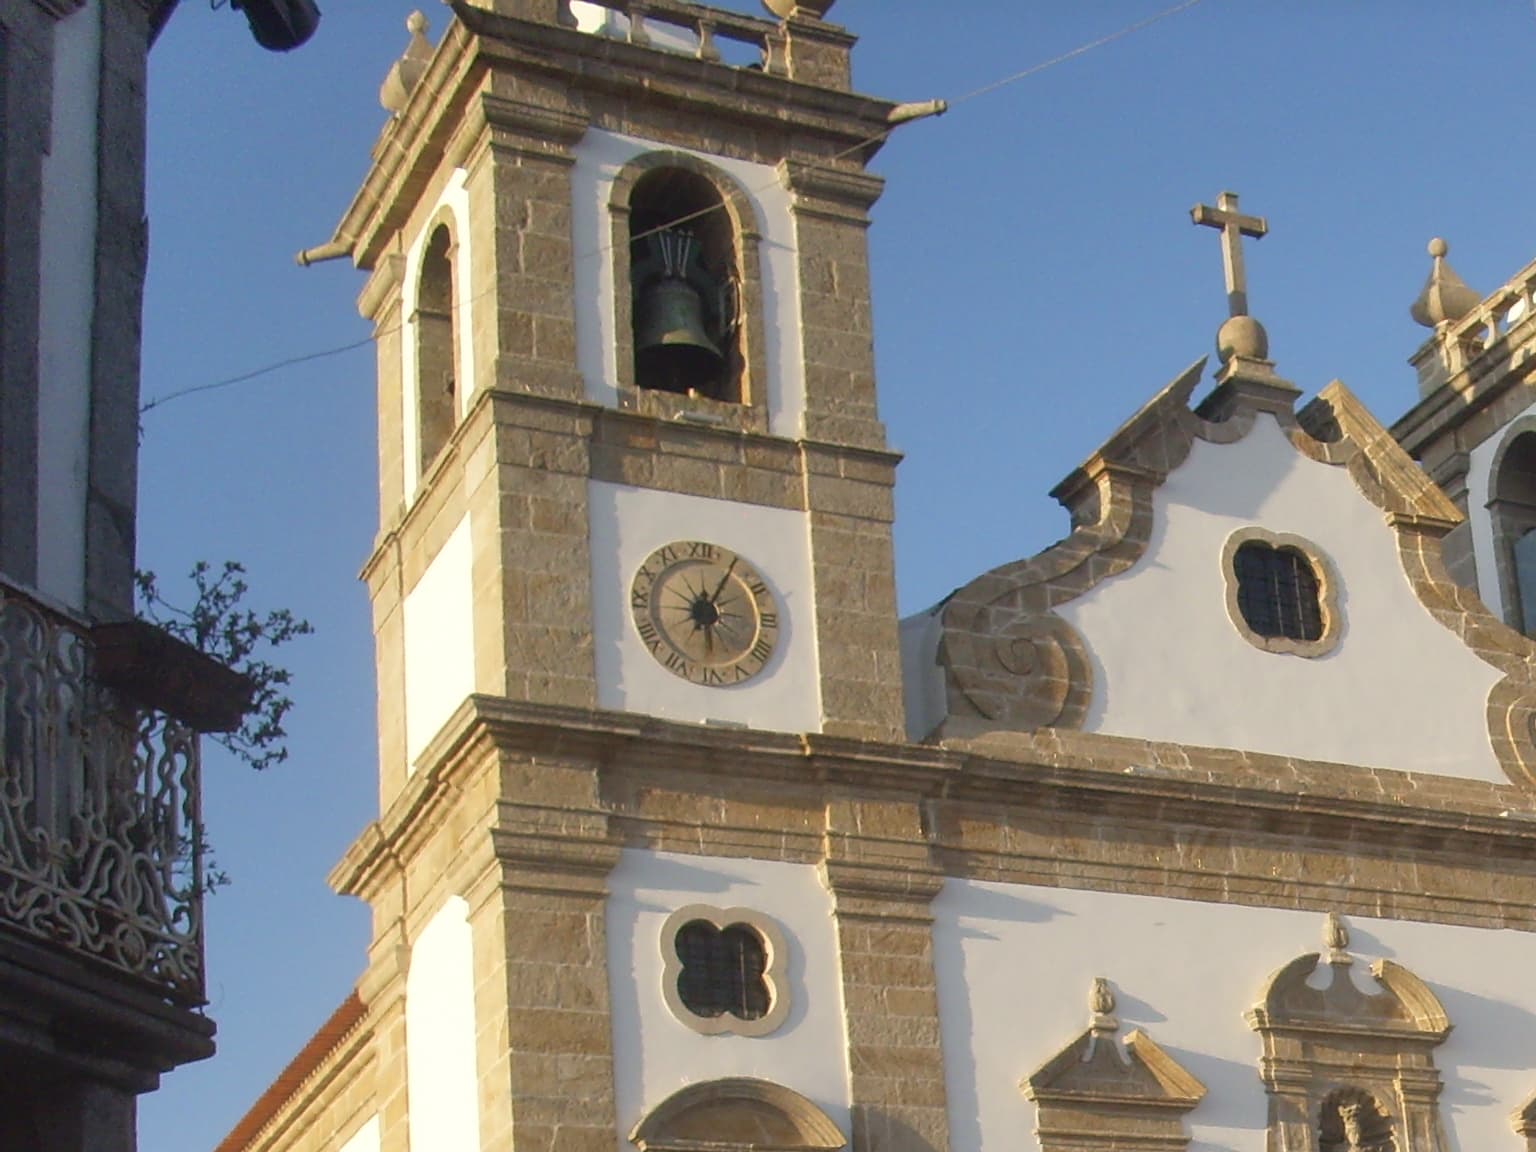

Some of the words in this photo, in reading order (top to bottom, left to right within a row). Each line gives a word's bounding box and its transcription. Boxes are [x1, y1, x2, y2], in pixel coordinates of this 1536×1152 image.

[656, 545, 678, 566] XI
[687, 542, 712, 558] XII
[640, 565, 656, 583] X
[750, 582, 767, 595] II
[632, 589, 649, 609] IX
[760, 613, 777, 628] III
[638, 623, 660, 654] VIII
[664, 653, 688, 677] VII
[735, 665, 750, 680] V
[703, 667, 723, 683] VI
